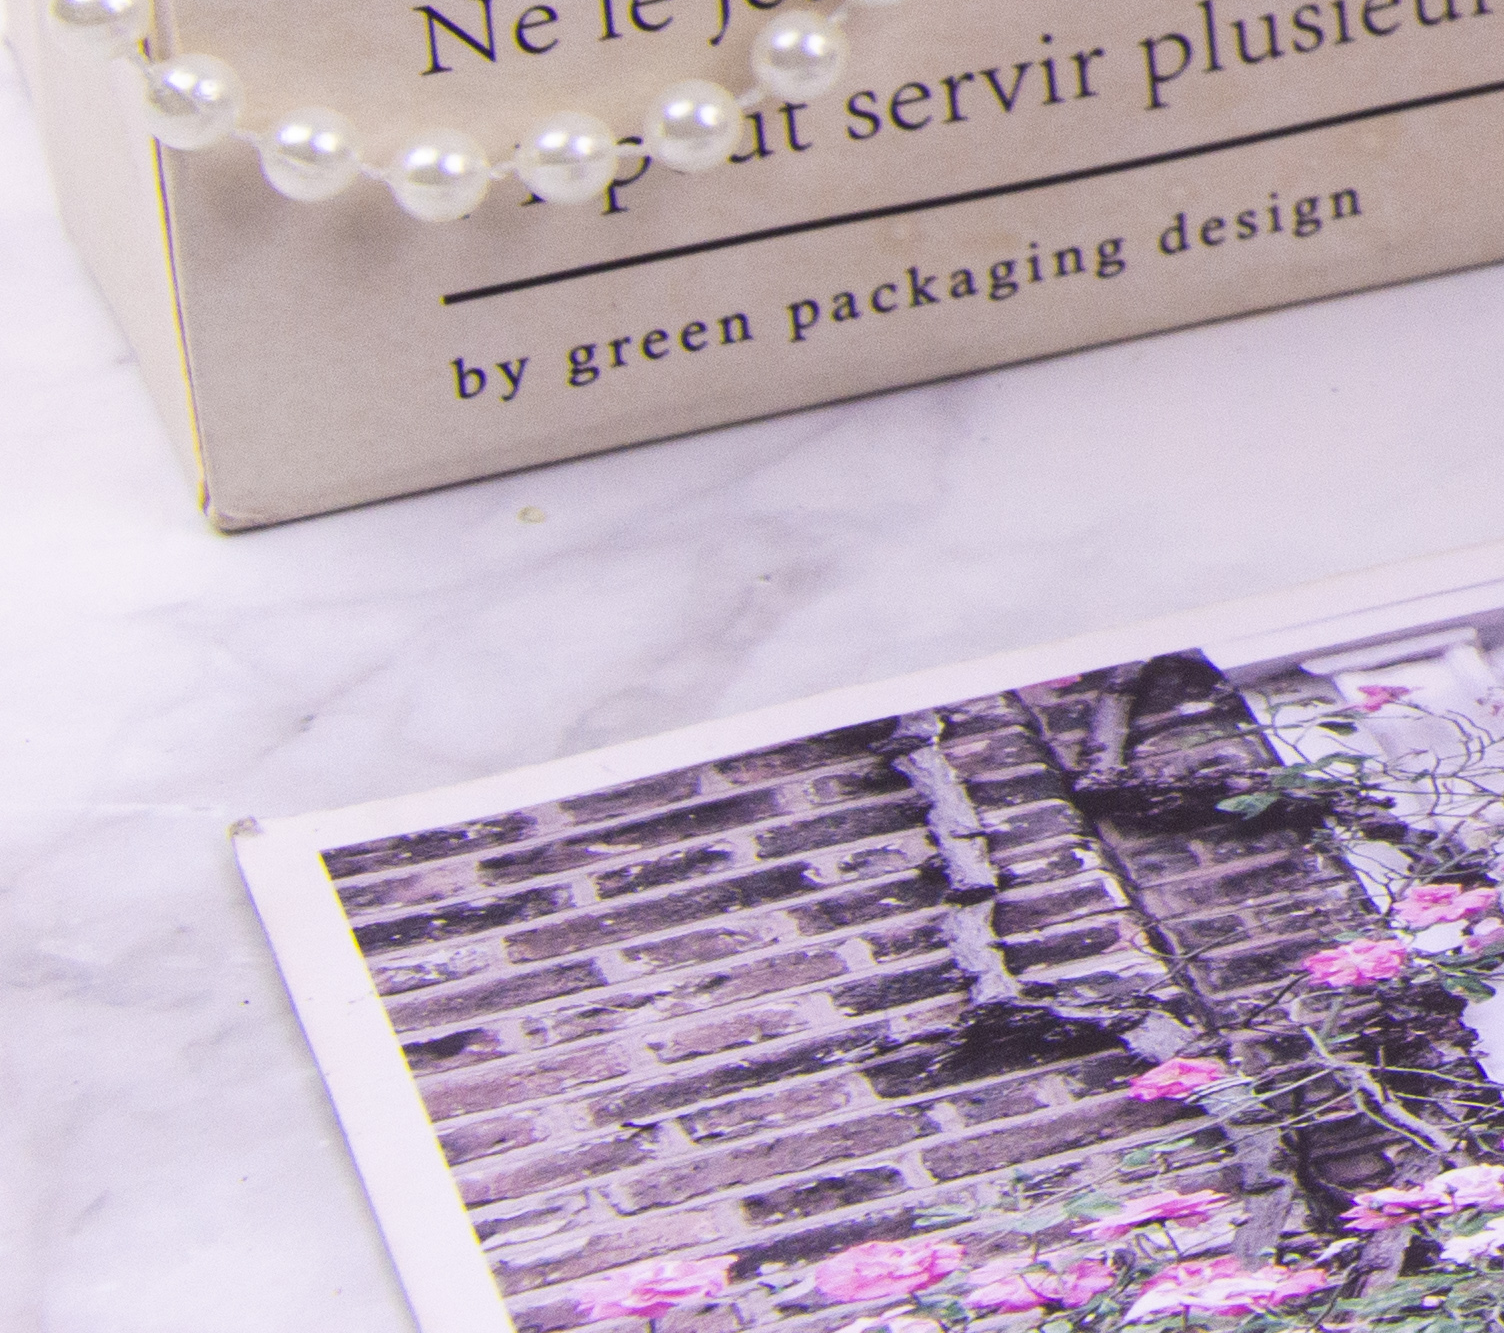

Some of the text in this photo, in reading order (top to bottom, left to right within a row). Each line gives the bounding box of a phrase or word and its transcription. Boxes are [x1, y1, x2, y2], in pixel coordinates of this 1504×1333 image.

[844, 32, 1106, 143] servir
[449, 184, 1366, 401] by green packaging design
